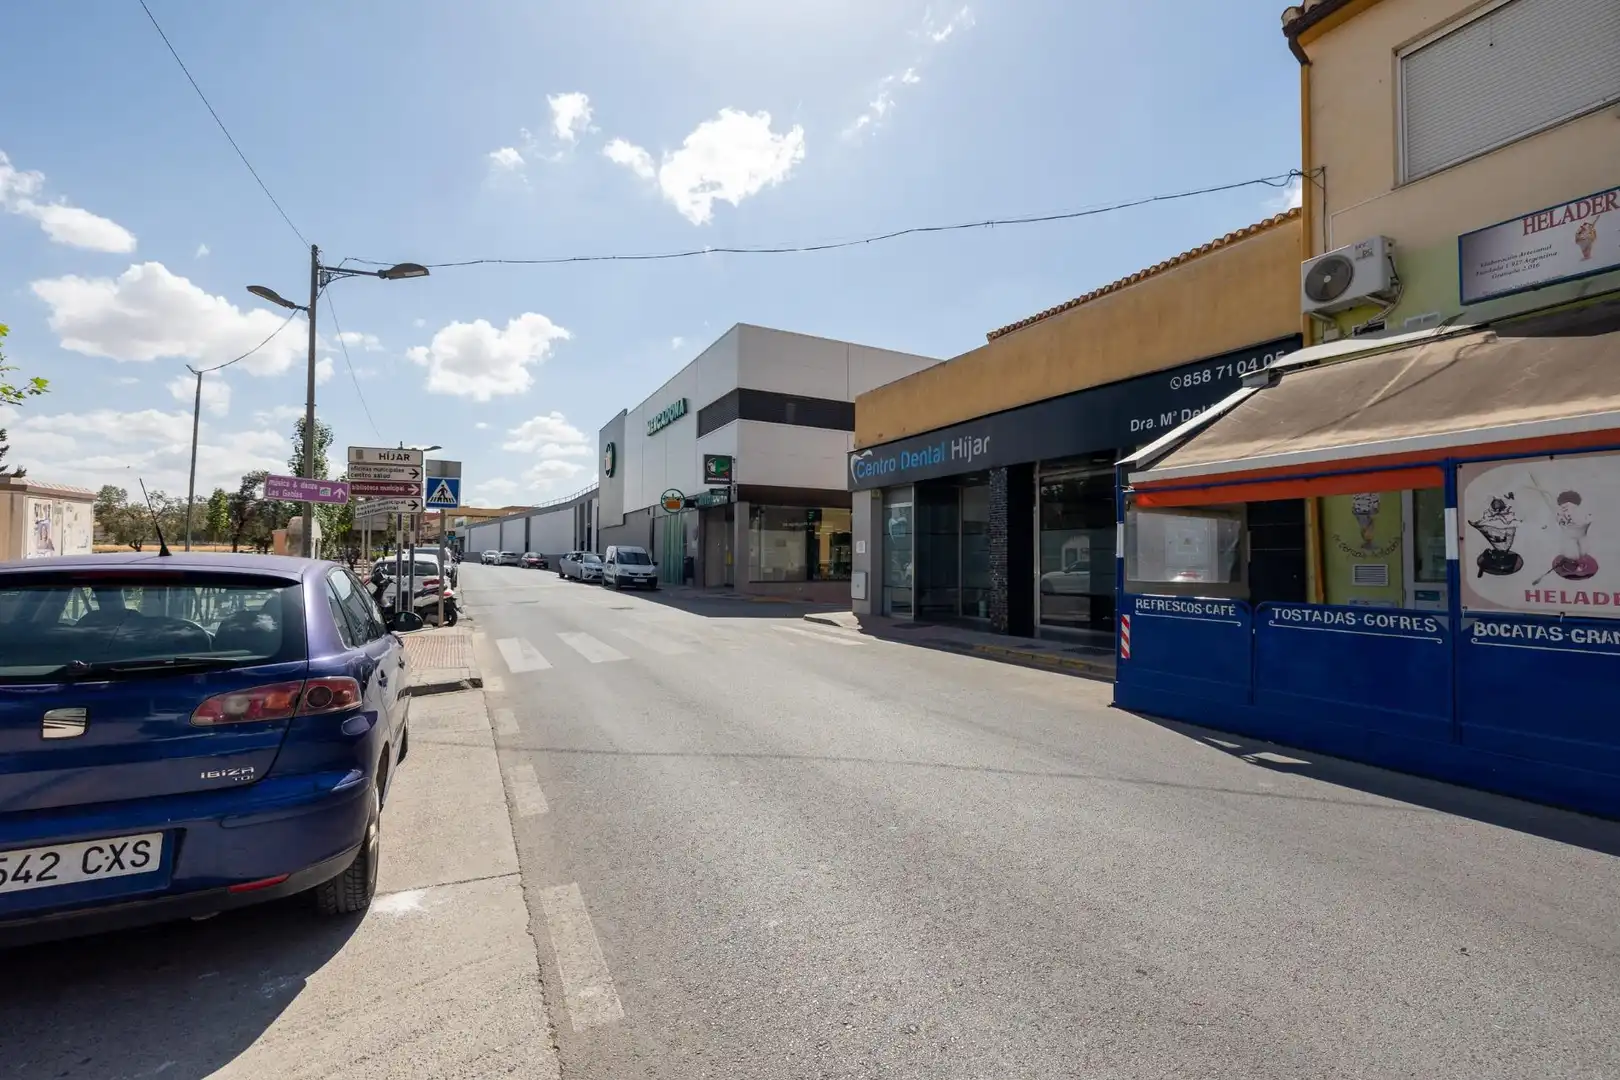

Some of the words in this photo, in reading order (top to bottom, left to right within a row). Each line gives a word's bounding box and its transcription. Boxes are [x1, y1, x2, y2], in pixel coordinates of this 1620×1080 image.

[1183, 369, 1211, 388] 858
[1130, 418, 1157, 432] Dra.
[378, 451, 411, 462] HÍJAR
[856, 456, 896, 479] Centro
[900, 442, 945, 471] Dental
[951, 435, 990, 463] Híjar
[351, 483, 379, 492] biblioteca
[380, 485, 405, 493] municipal
[81, 839, 151, 875] CXS
